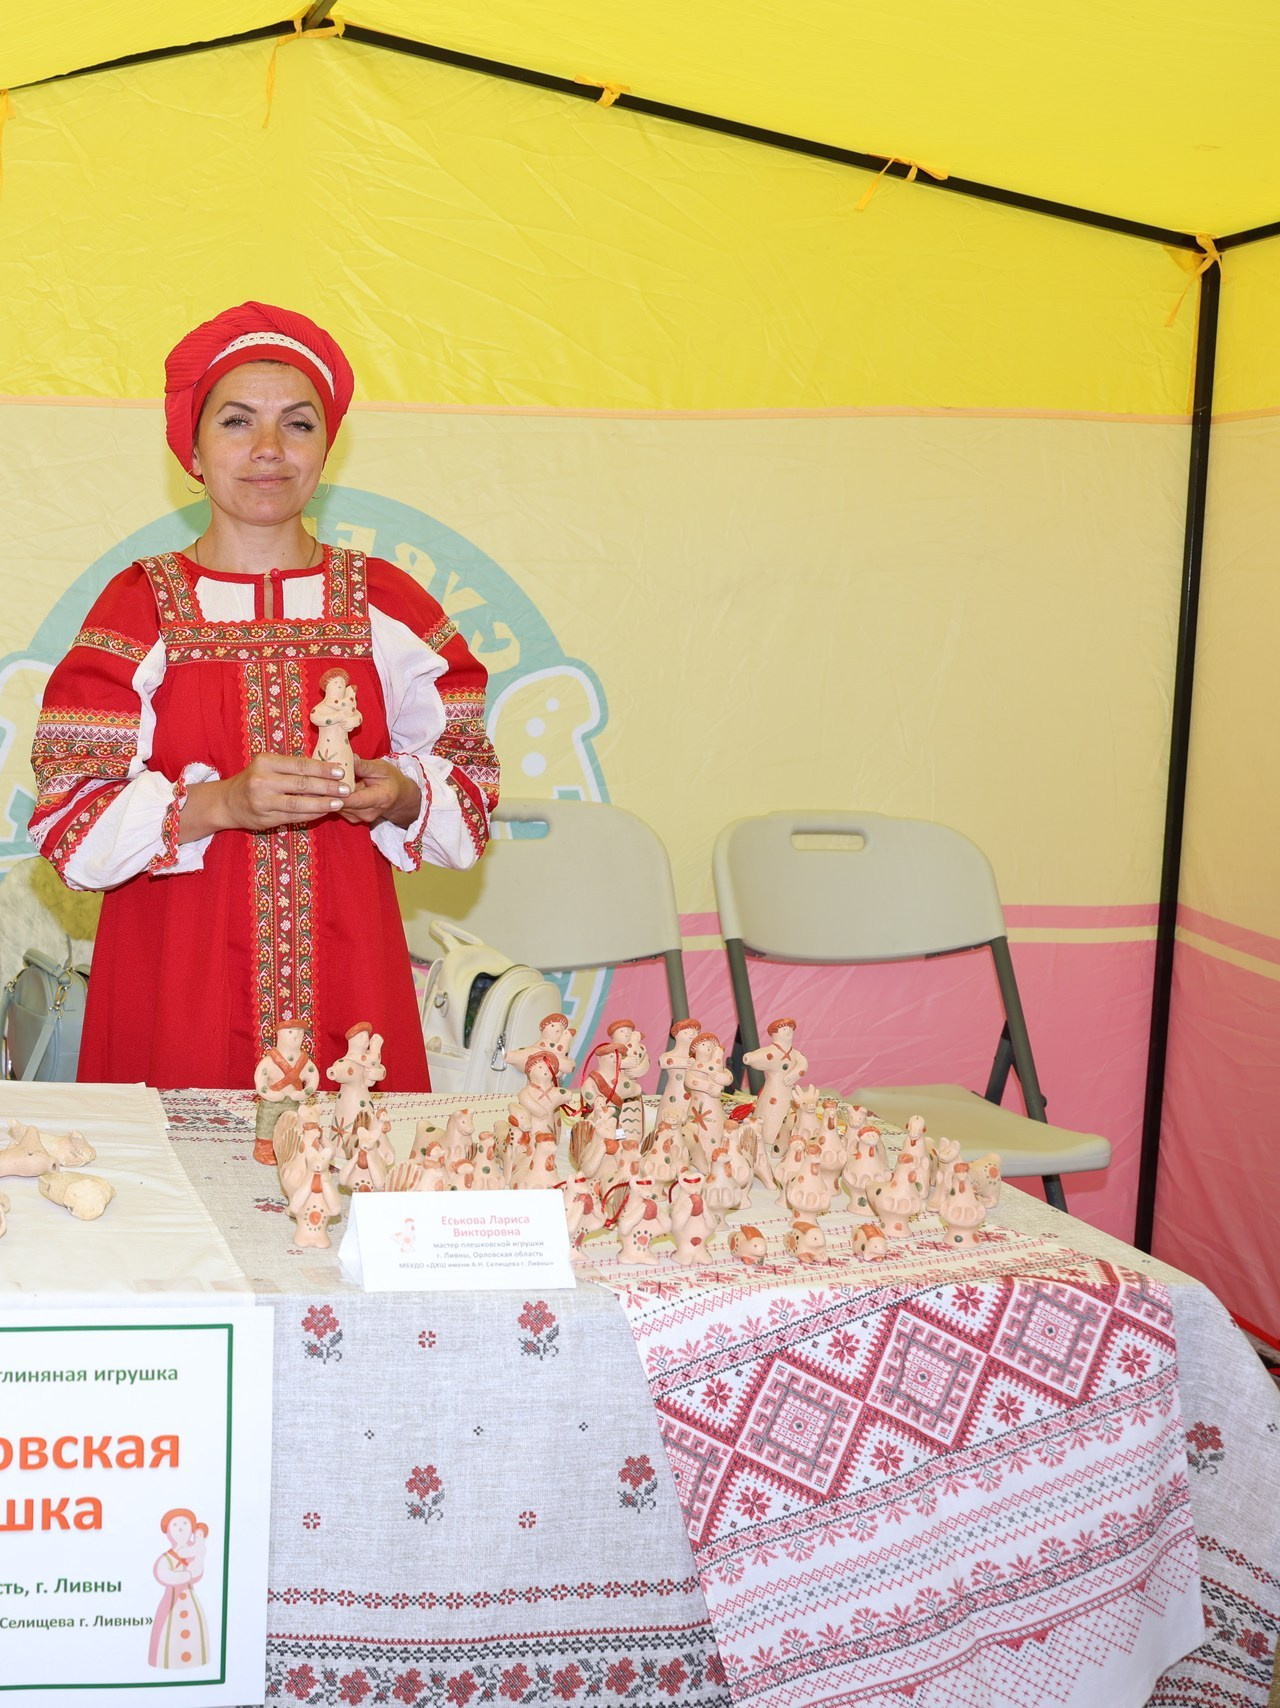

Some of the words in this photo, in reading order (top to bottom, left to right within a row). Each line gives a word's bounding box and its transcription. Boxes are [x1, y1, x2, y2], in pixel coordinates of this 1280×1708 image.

[441, 1215, 486, 1226] Еськова
[490, 1215, 530, 1226] Лариса
[453, 1227, 521, 1238] Викторовна
[433, 1242, 459, 1250] мастер
[460, 1240, 511, 1249] плешковской
[444, 1252, 471, 1260] Ливны,
[473, 1251, 513, 1260] Орловская
[93, 1367, 179, 1386] игрушка
[35, 1581, 49, 1595] г.
[53, 1577, 123, 1595] Ливны
[79, 1617, 89, 1628] г.
[92, 1614, 154, 1632] Ливны»
